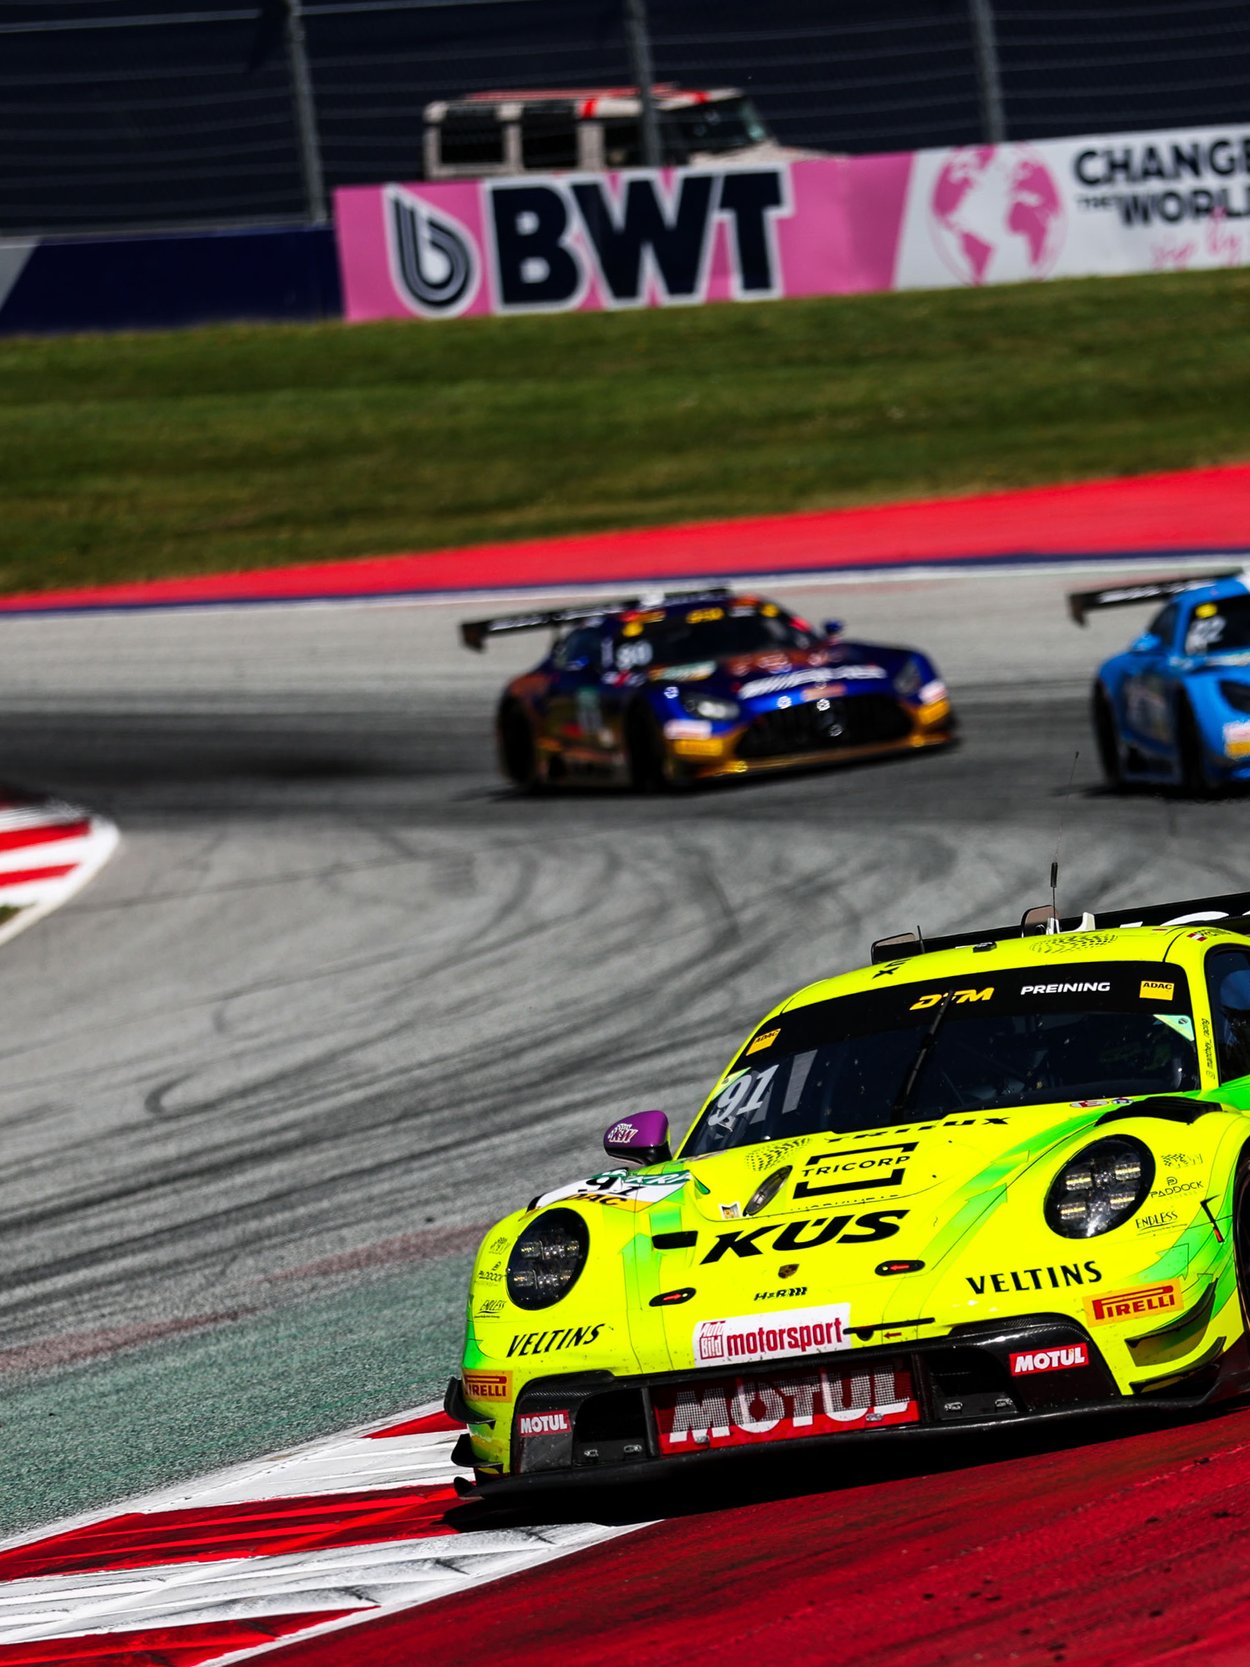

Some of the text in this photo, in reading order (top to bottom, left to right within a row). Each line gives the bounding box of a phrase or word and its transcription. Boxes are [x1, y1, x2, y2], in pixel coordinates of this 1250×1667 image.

[486, 167, 791, 312] BWT
[1021, 982, 1111, 995] PREINING
[1143, 982, 1173, 990] ADAC
[708, 1064, 779, 1126] 91
[802, 1155, 911, 1177] TRICORP
[1150, 1181, 1203, 1198] PADDOCK
[1136, 1211, 1178, 1228] ENDLESS
[700, 1210, 911, 1265] KÜS
[965, 1260, 1102, 1295] VELTINS
[1092, 1285, 1175, 1320] PIRELLI
[506, 1323, 606, 1357] VELTINS
[701, 1318, 842, 1358] Bild motorsport
[1015, 1347, 1085, 1373] MOTUL
[669, 1366, 911, 1443] MOTUL
[520, 1414, 568, 1434] MOTUL
